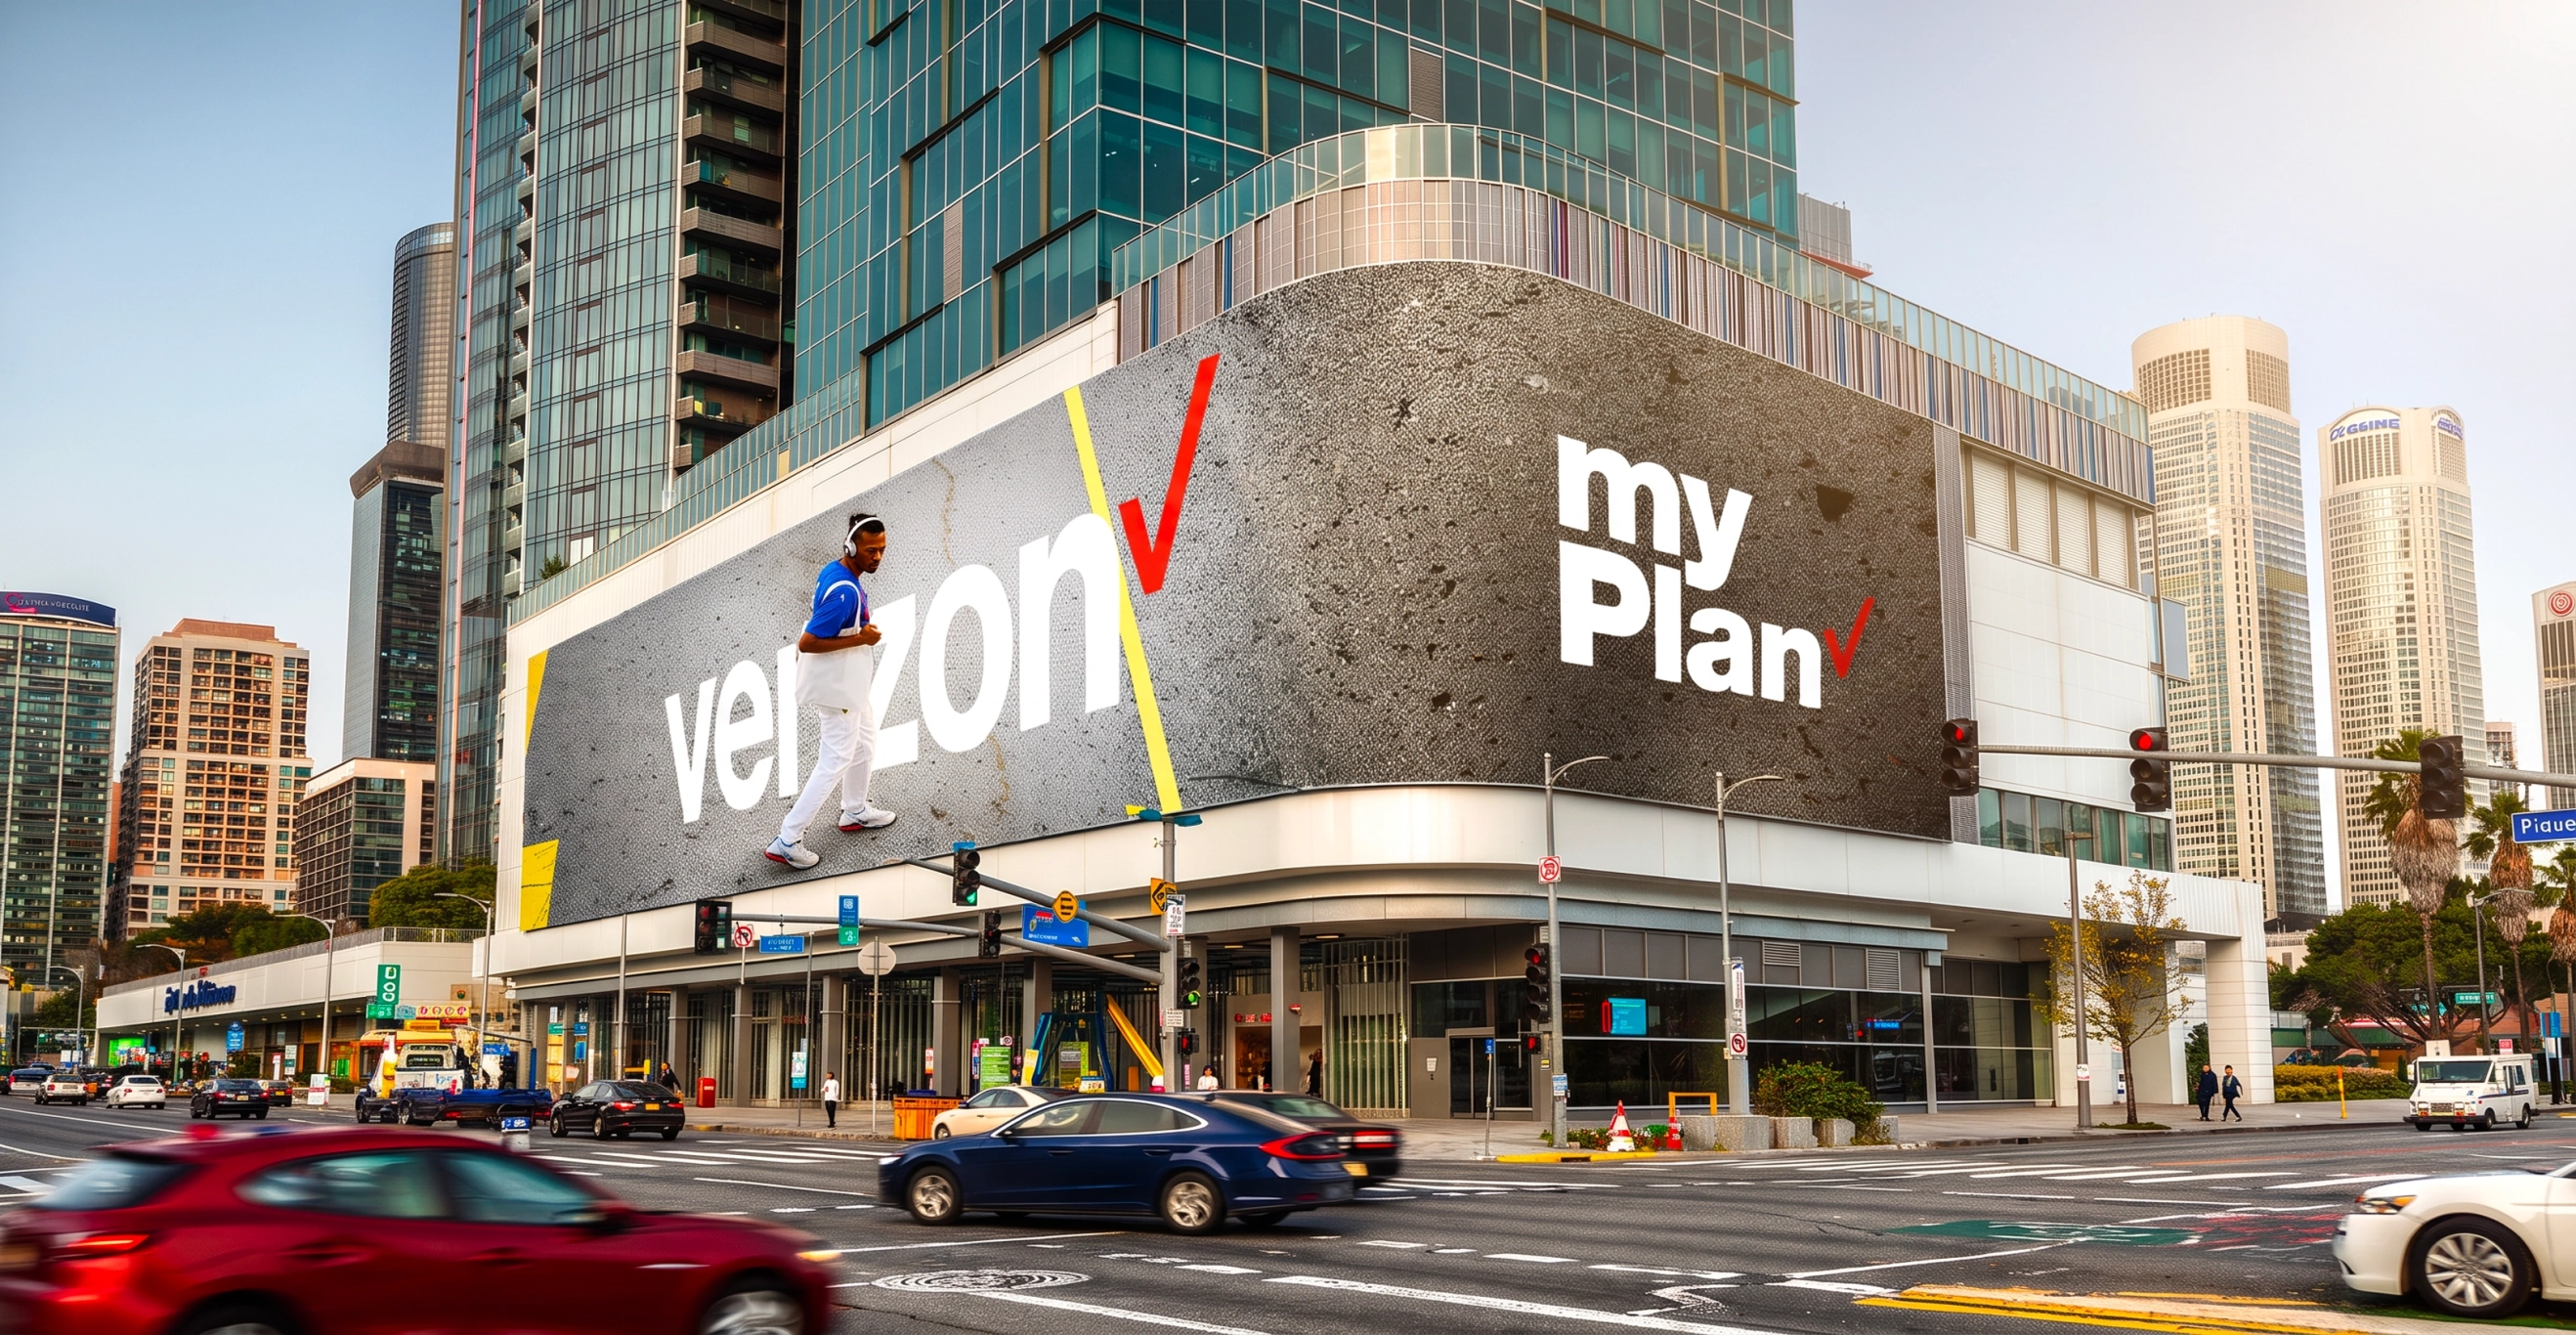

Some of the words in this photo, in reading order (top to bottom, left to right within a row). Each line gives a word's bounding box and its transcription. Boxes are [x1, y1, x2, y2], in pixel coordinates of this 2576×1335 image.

[1558, 434, 1753, 591] my
[665, 513, 1121, 824] verzon
[1560, 539, 1822, 710] Plan
